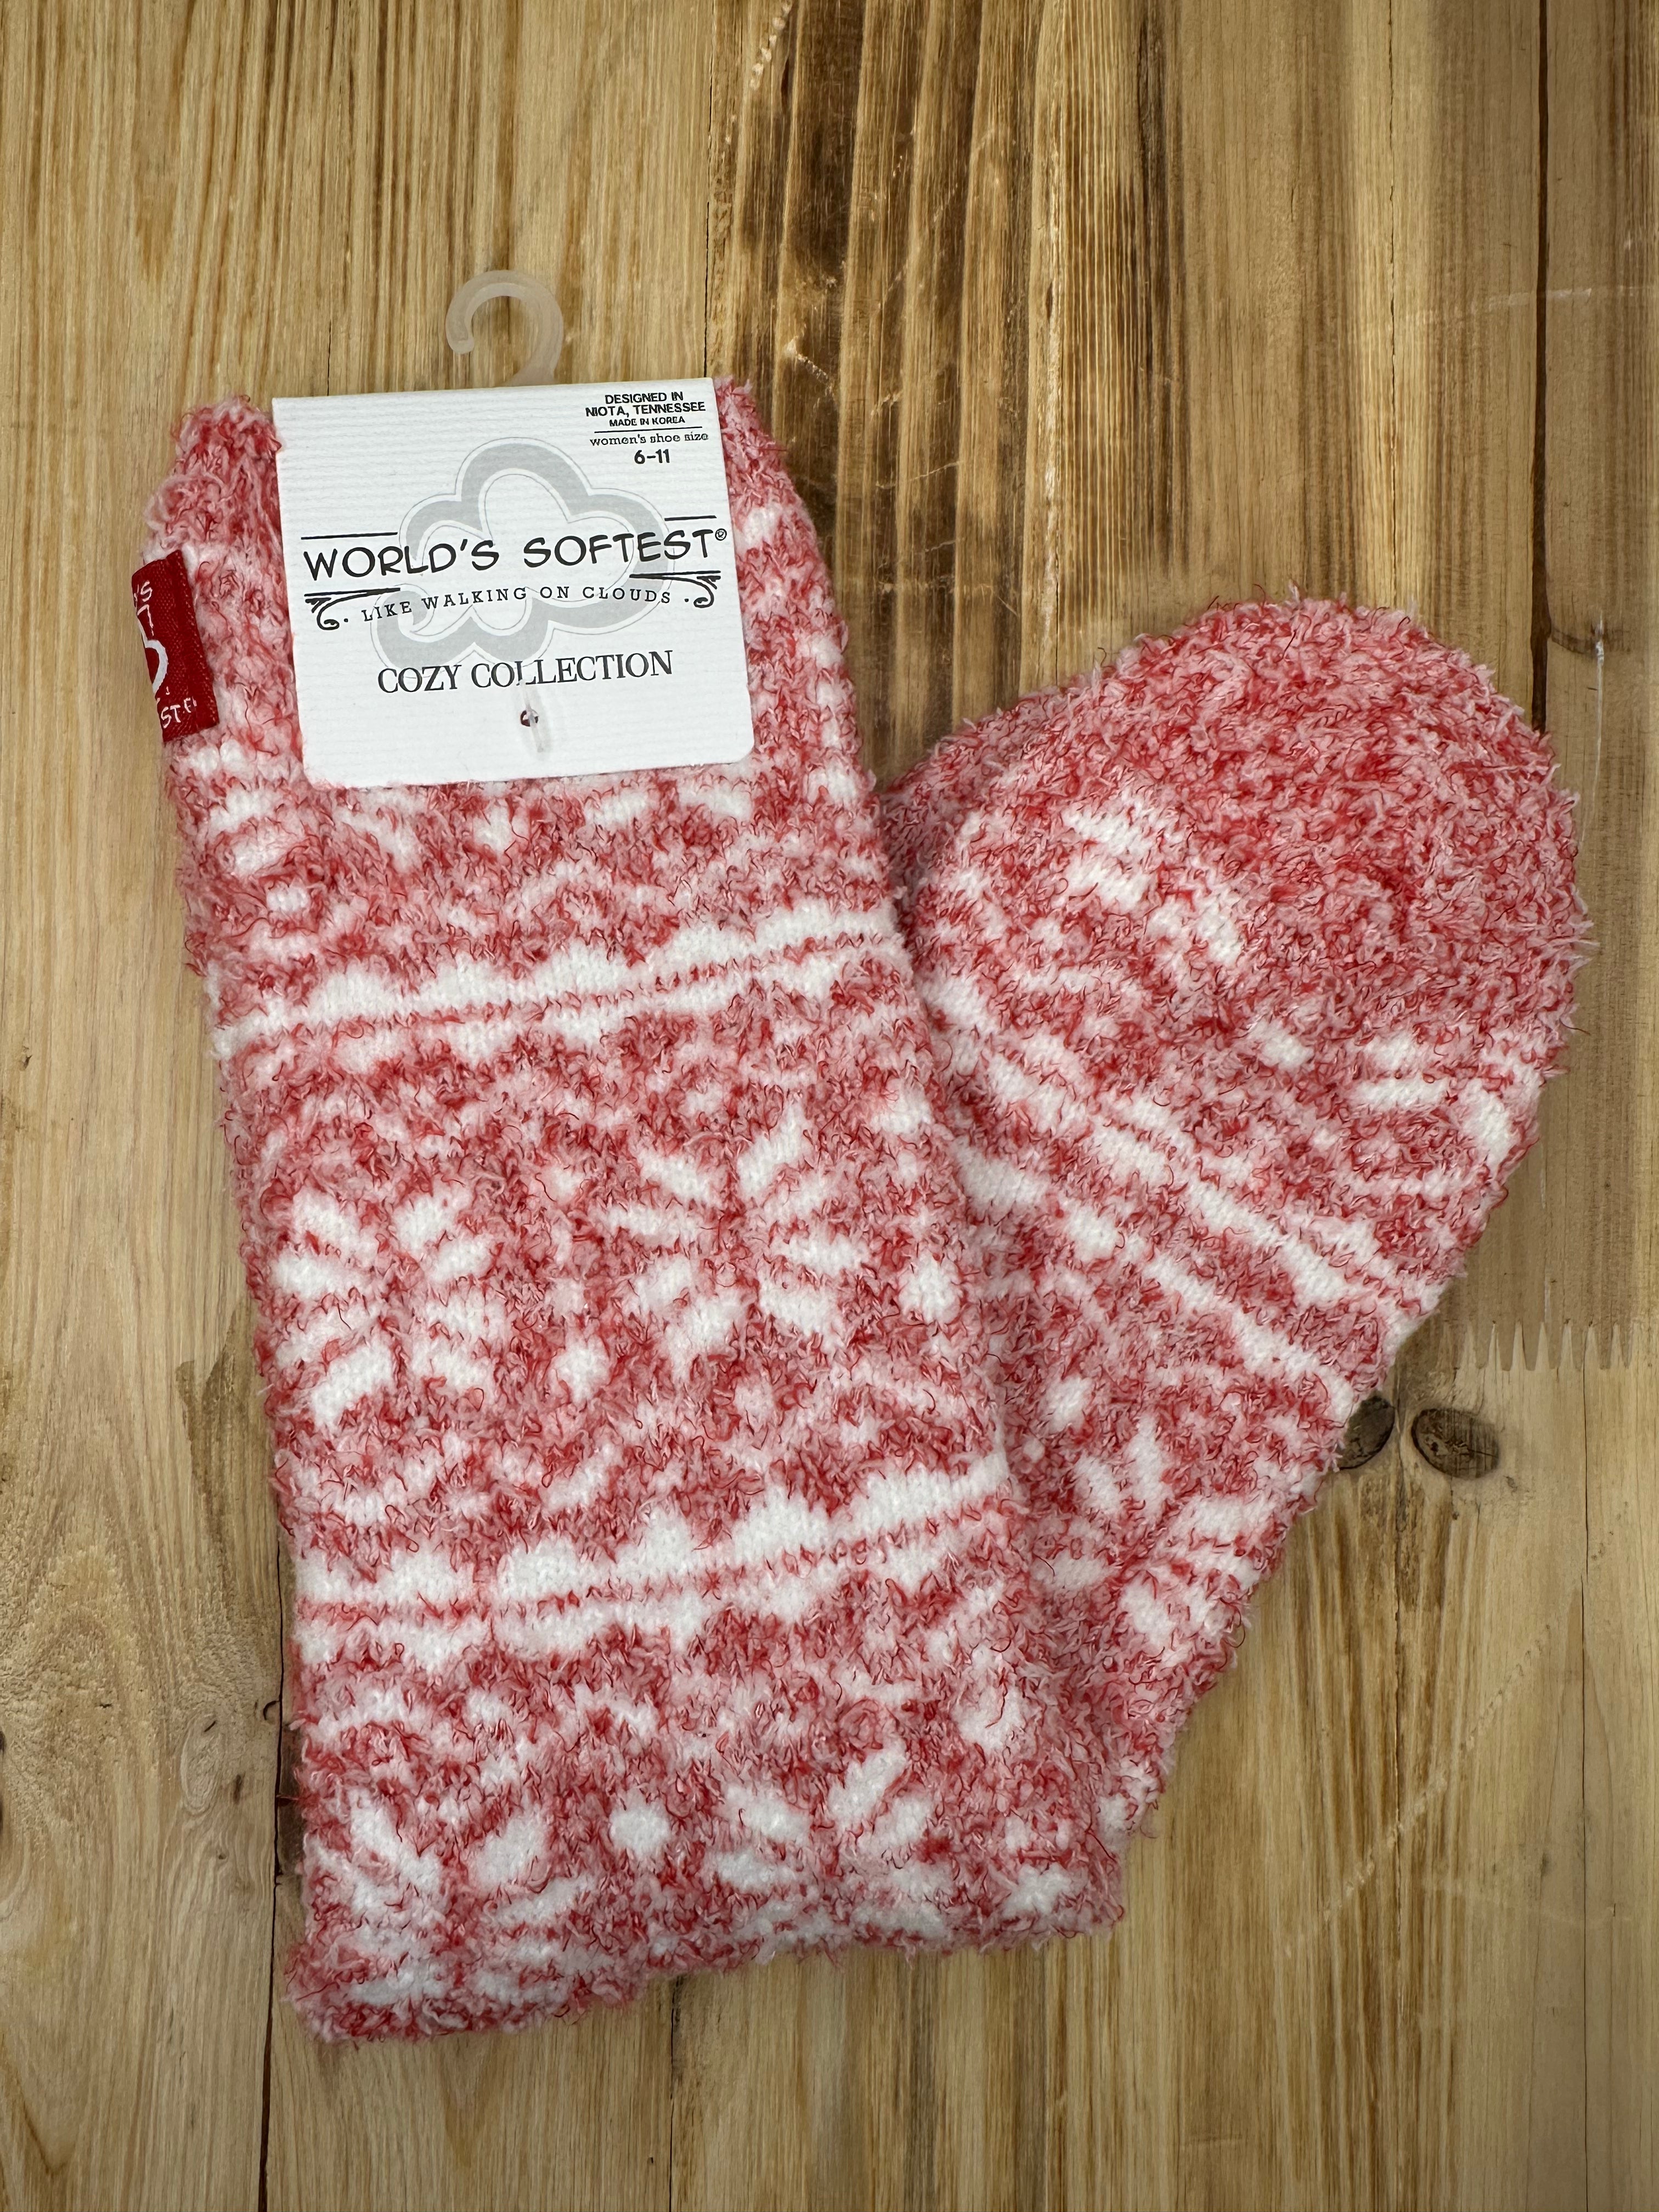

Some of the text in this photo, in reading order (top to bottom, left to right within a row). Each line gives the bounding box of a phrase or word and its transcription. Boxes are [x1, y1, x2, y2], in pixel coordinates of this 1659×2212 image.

[605, 391, 684, 404] DESIGNED IN
[585, 402, 706, 417] NIOTA, TENNESSEE
[609, 418, 637, 427] MADE
[652, 416, 685, 425] KOREA
[590, 431, 709, 446] women's shoe size
[634, 449, 670, 465] 6-11
[303, 538, 500, 581] WORLD'S
[361, 586, 671, 622] LIKE WALKING ON CLOUDS
[377, 650, 674, 693] COZY COLLECTION
